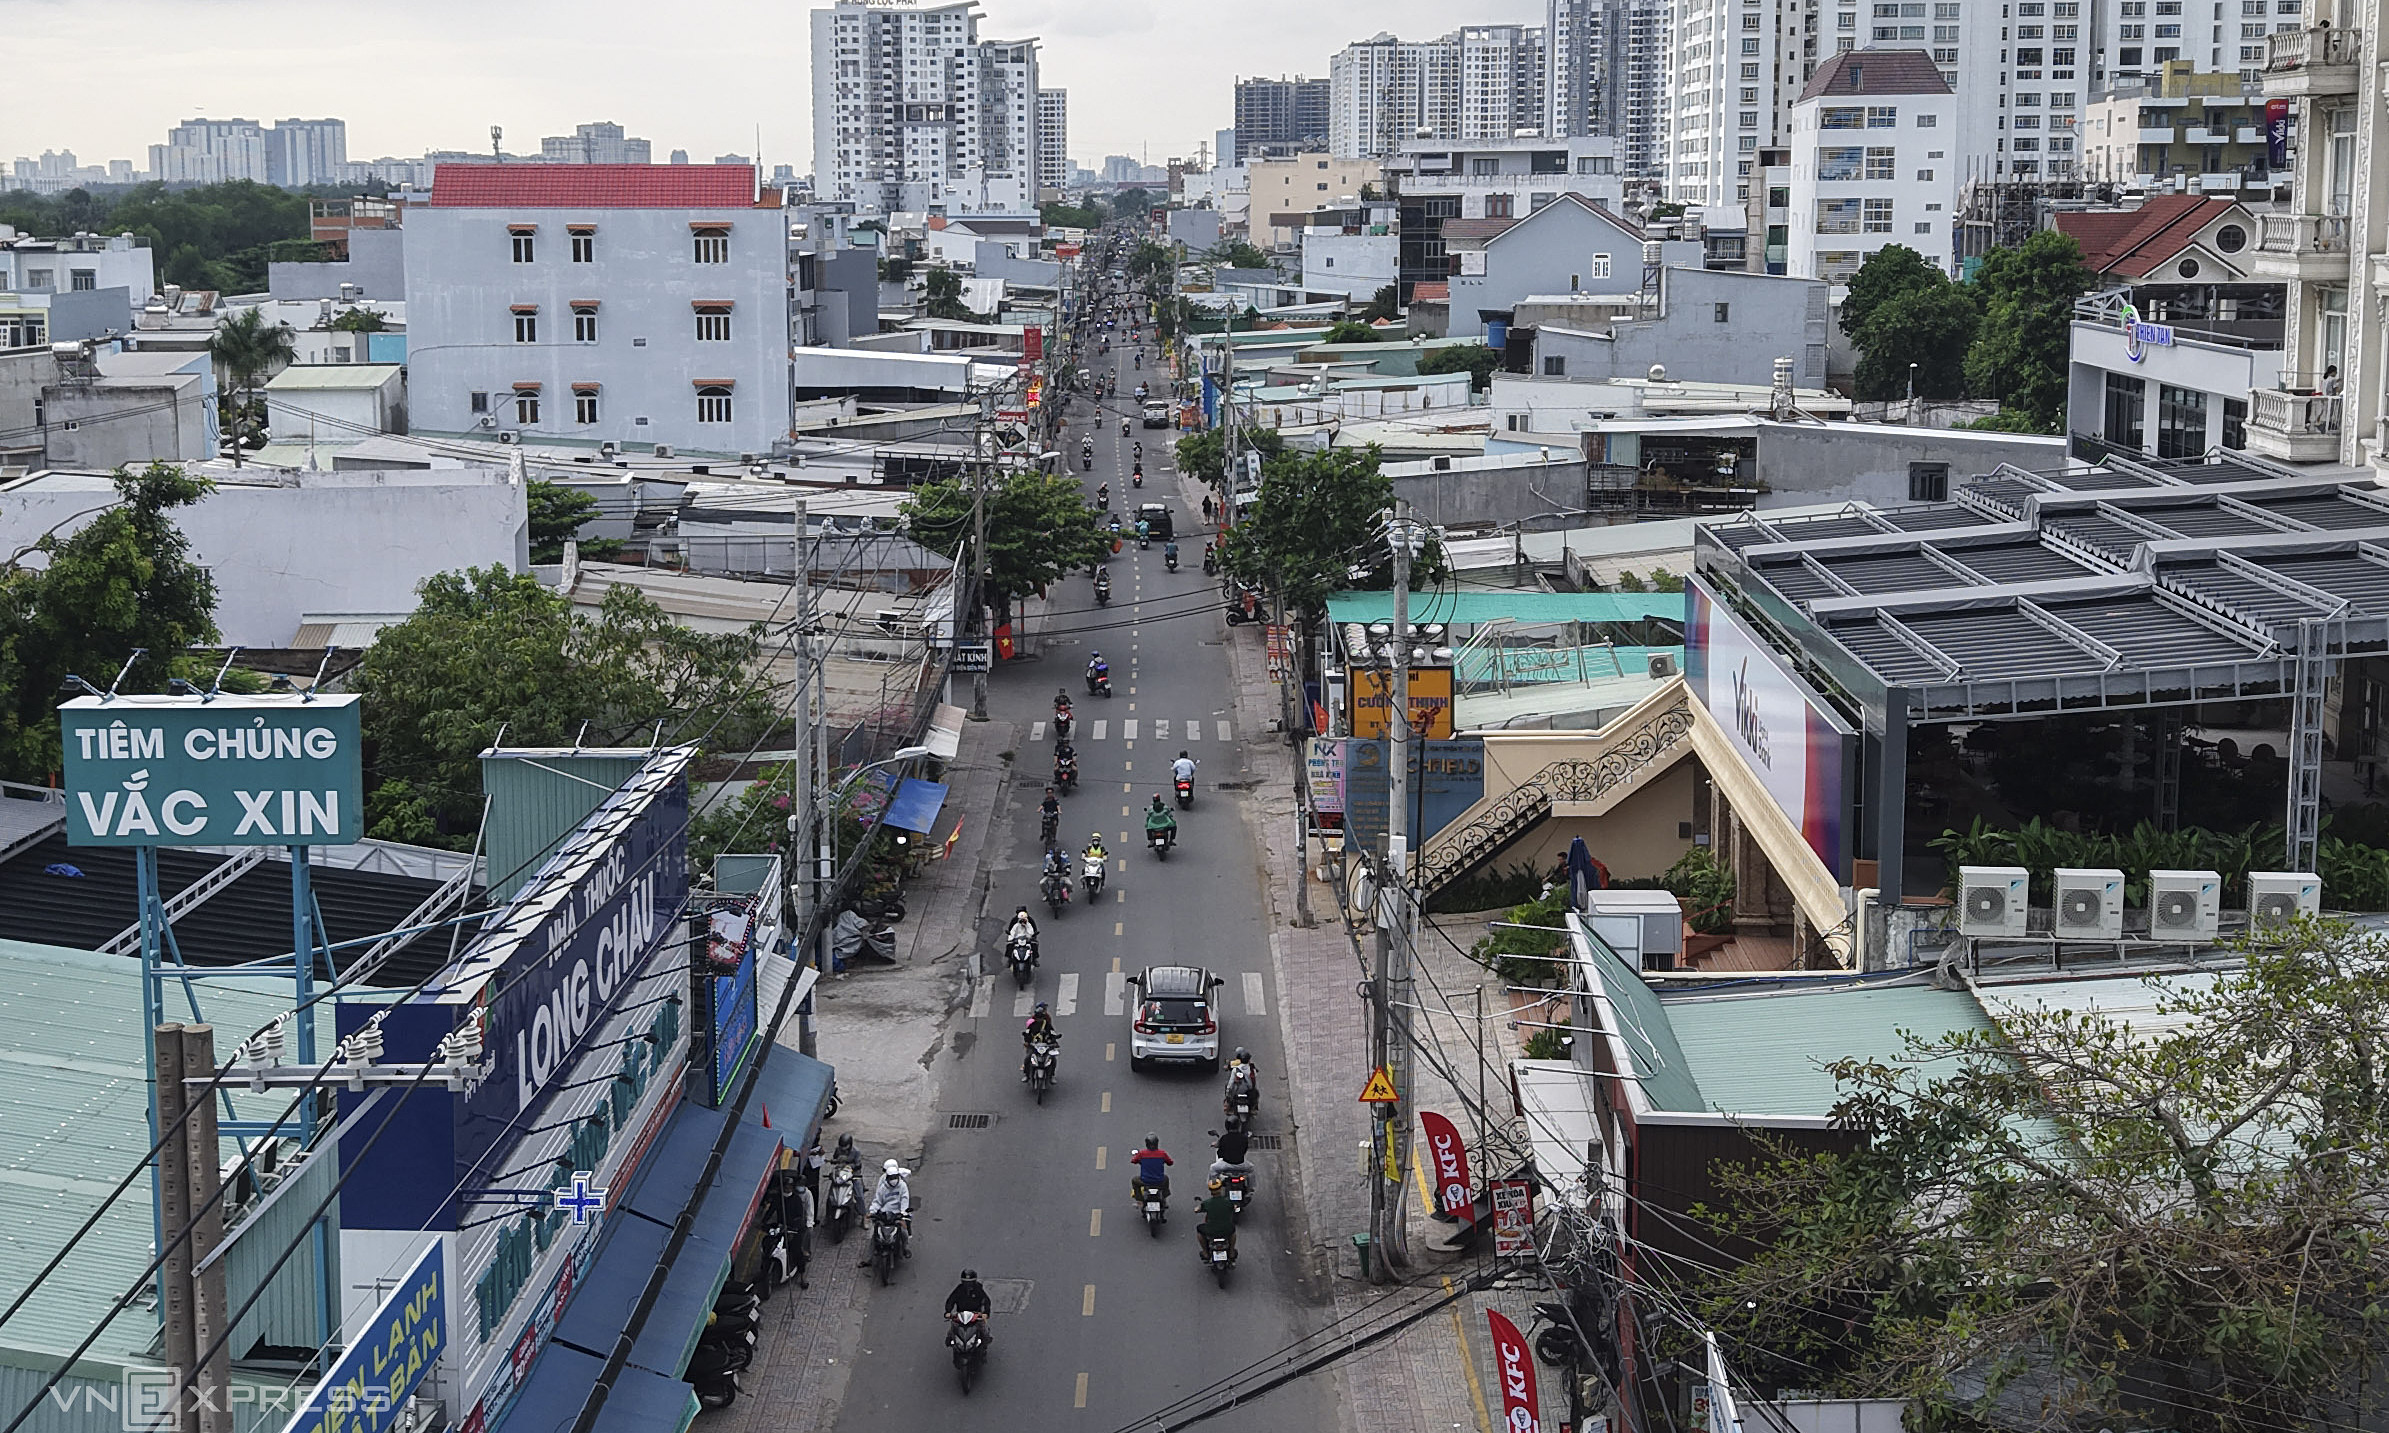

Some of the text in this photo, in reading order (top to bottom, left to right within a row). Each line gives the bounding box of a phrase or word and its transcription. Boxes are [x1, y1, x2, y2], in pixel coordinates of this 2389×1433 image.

[75, 716, 337, 760] TIÊM CHỦNG
[77, 769, 339, 836] VẮC XIN
[518, 958, 590, 1111] LONG
[596, 870, 654, 1002] CHÂU
[1435, 1133, 1460, 1179] KFC
[373, 1271, 437, 1376] LẠNH
[389, 1317, 438, 1405] BẢN
[1501, 1342, 1528, 1403] KFC
